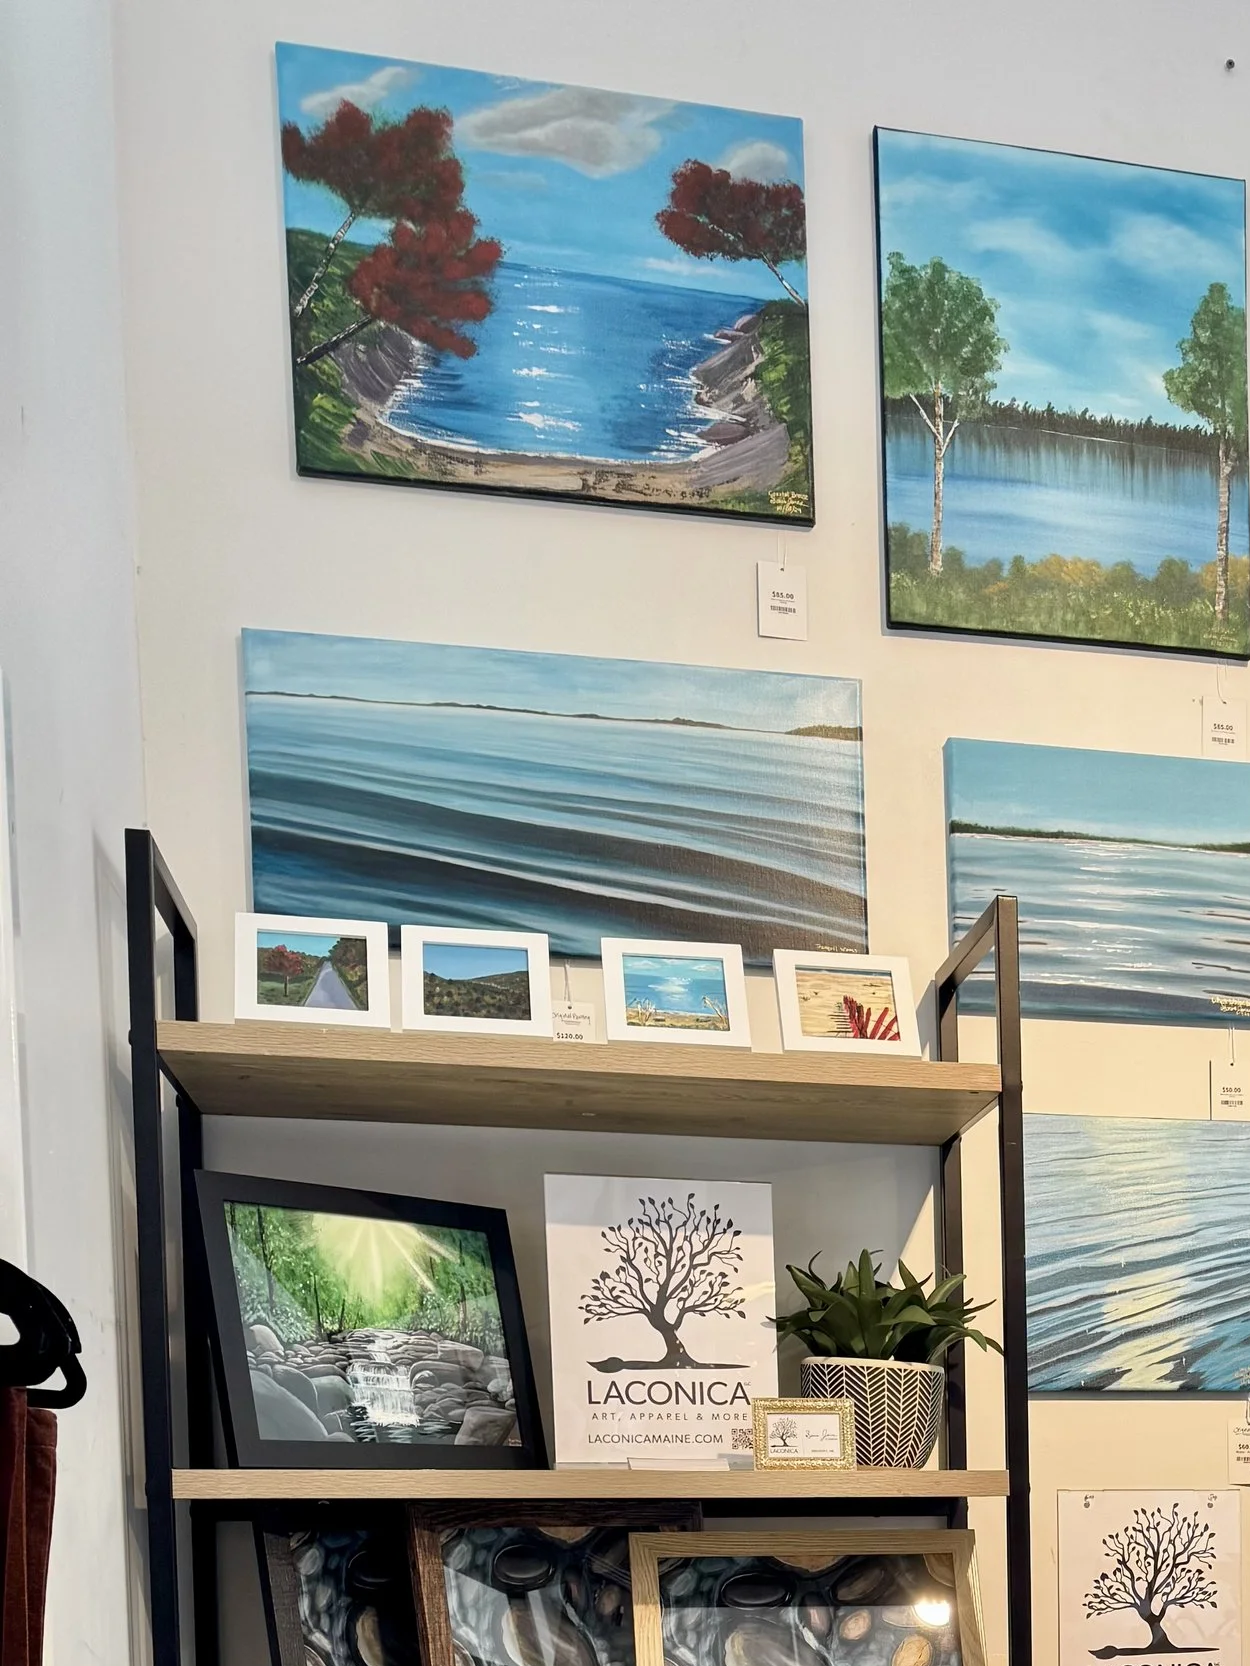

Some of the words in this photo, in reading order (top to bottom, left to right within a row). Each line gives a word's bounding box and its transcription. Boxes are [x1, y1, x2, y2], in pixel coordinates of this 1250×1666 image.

[556, 1032, 584, 1040] $120.00
[586, 1380, 751, 1406] LACONICA
[592, 1412, 622, 1422] ART,
[629, 1412, 689, 1421] APPAREL
[696, 1412, 704, 1421] &
[711, 1412, 748, 1421] MORE
[588, 1434, 724, 1444] LACONICAMAINE.COM
